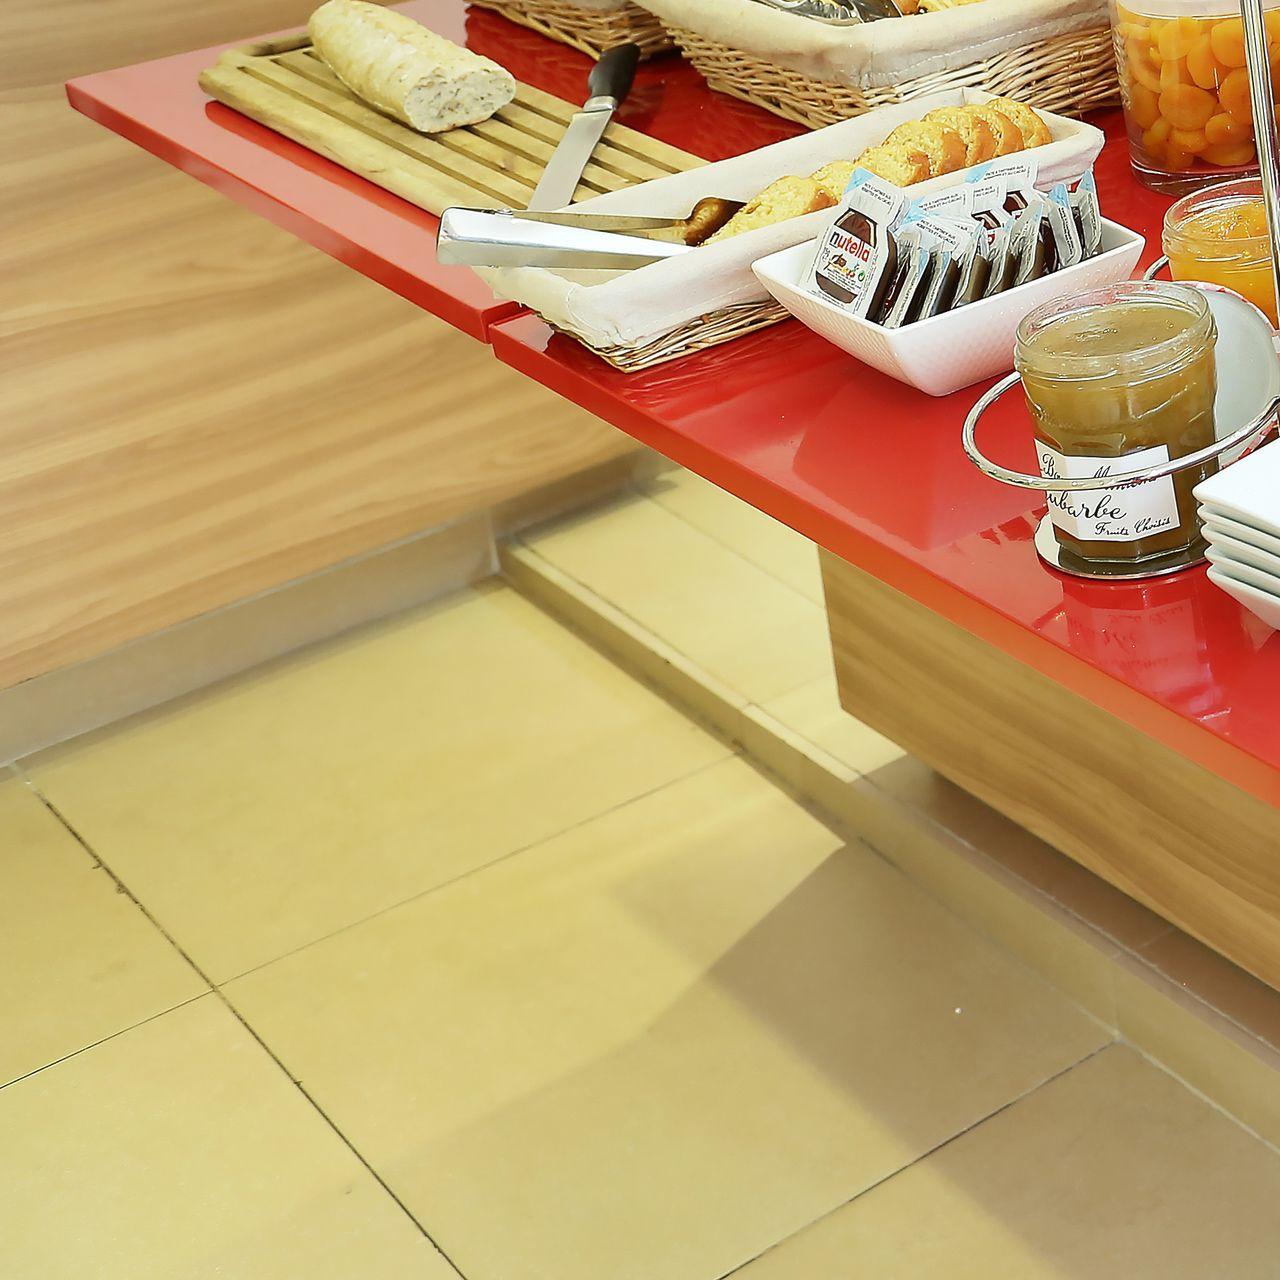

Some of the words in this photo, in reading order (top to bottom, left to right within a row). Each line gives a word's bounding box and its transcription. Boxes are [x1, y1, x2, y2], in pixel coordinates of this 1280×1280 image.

[830, 231, 871, 262] nutella
[1046, 490, 1126, 519] ubarbe
[1095, 521, 1129, 536] Fruits
